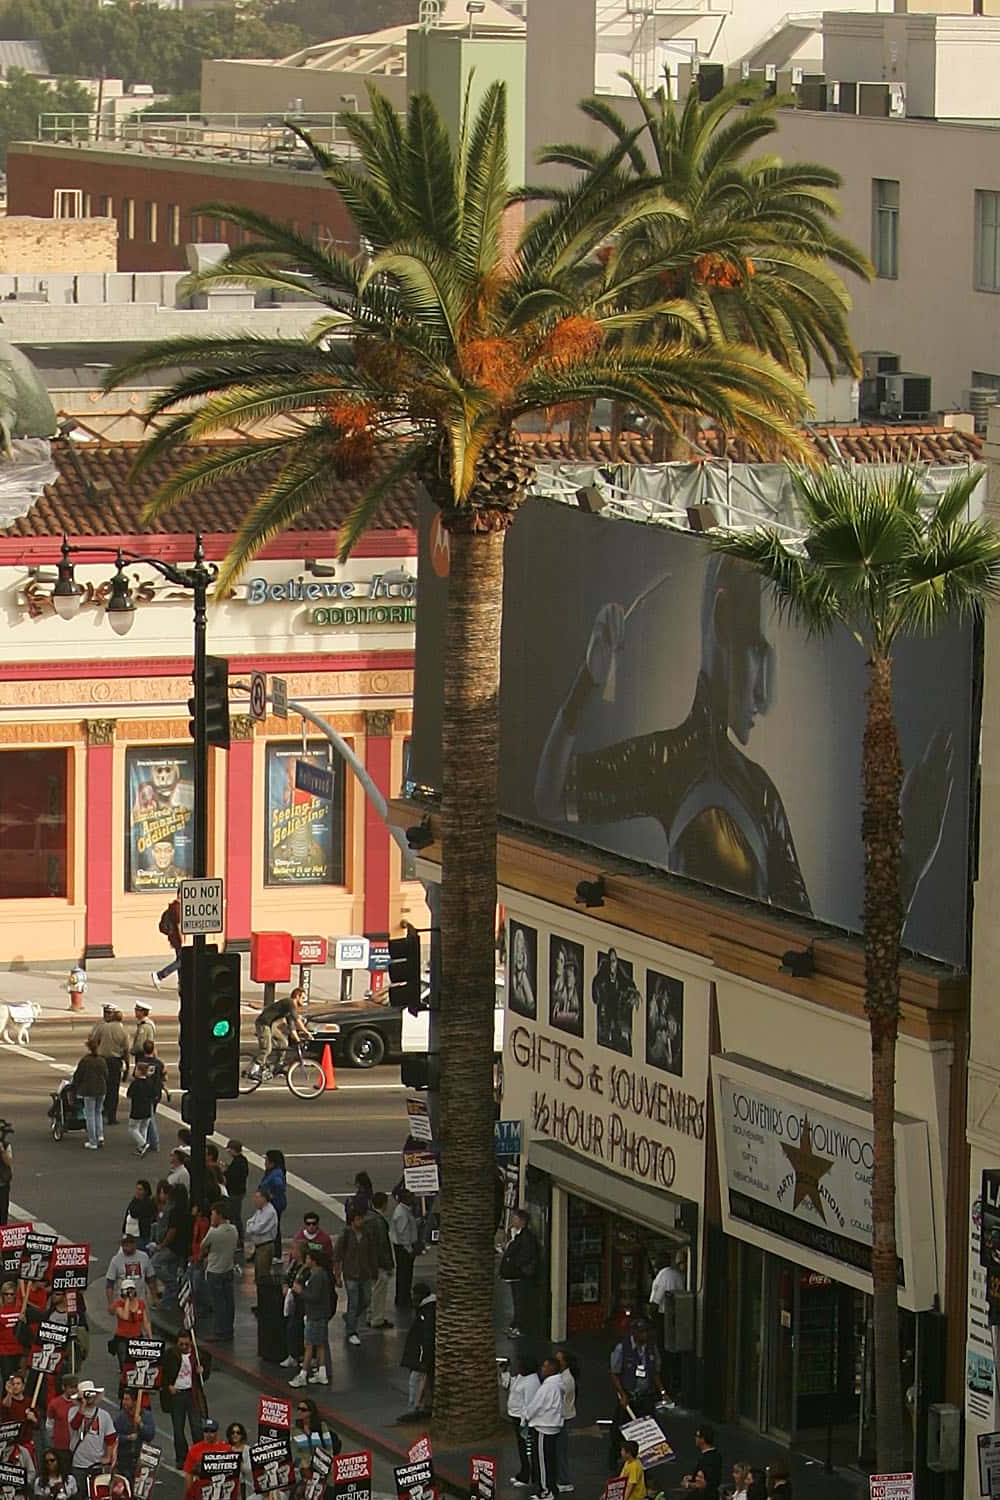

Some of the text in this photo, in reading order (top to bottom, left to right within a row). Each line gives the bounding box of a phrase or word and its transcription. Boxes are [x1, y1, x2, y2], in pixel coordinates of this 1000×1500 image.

[247, 576, 354, 604] Believe
[184, 886, 220, 899] DO NOT
[185, 904, 218, 916] BLOCK
[511, 1026, 706, 1140] GIFTS & SOUVENIRS
[733, 1093, 784, 1136] SOUVENIRS
[552, 1100, 676, 1188] HOUR PHOTO
[872, 1487, 885, 1496] NO
